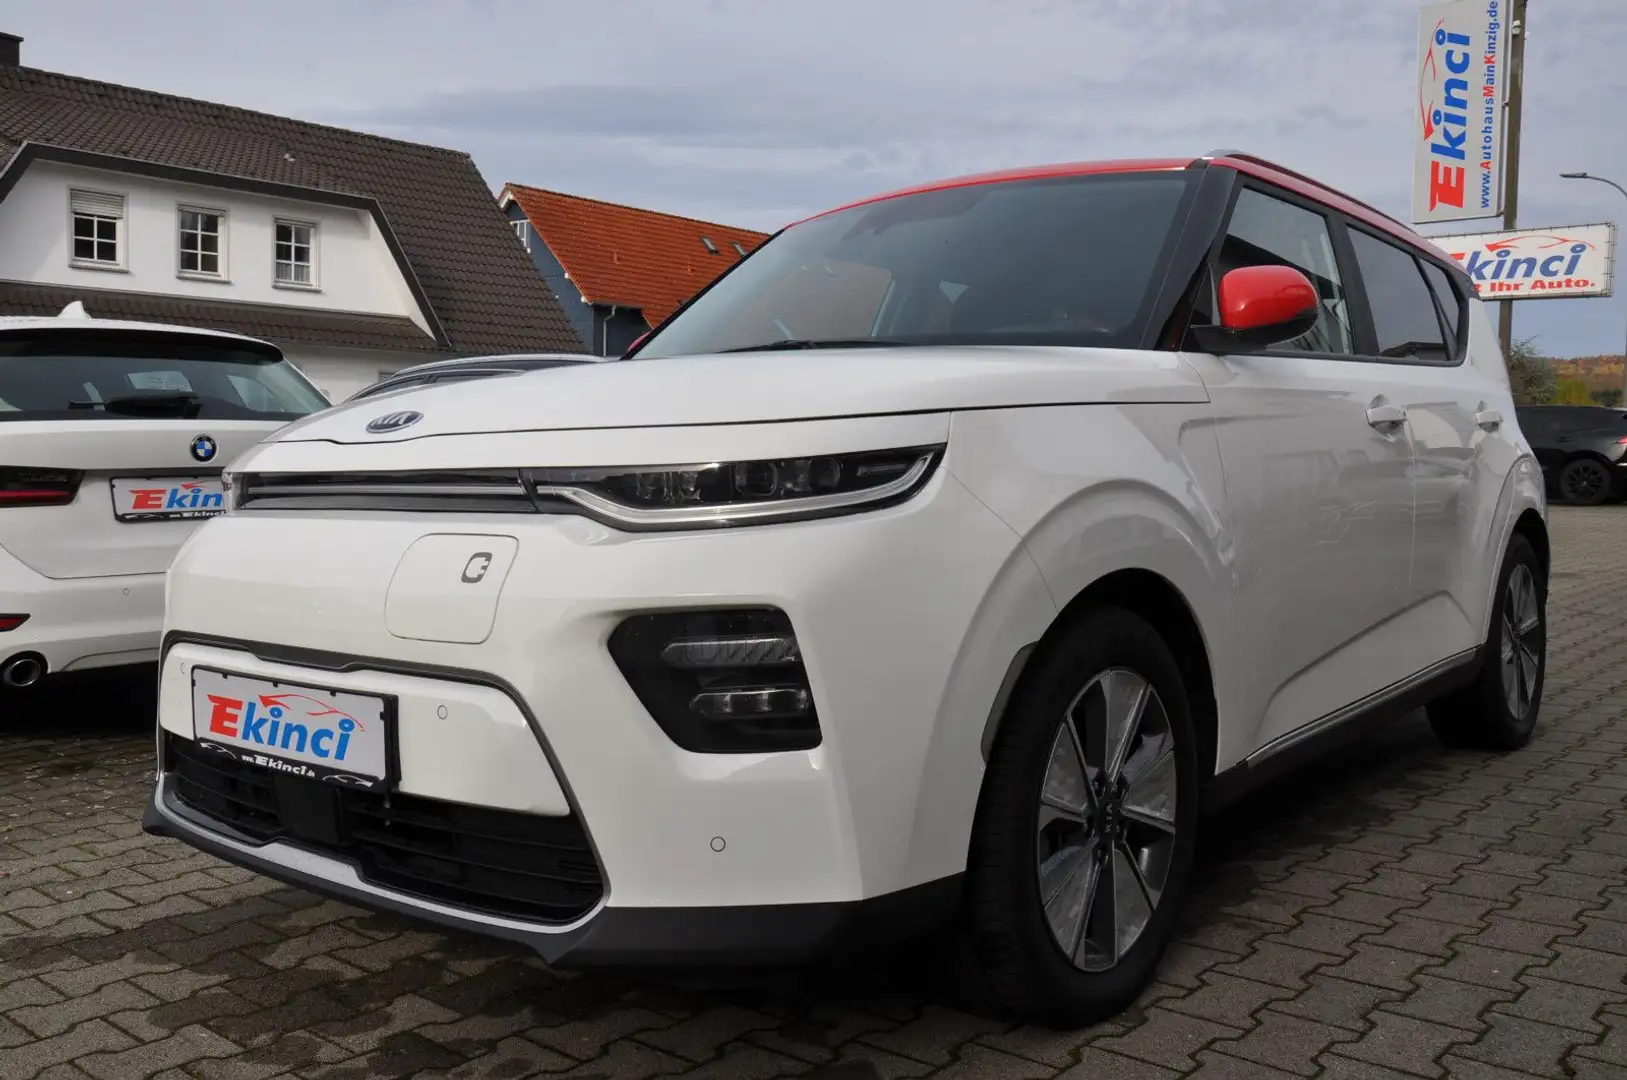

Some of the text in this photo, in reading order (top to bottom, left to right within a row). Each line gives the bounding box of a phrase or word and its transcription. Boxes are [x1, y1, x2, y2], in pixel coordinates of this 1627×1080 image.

[1429, 28, 1471, 213] Ekinci
[1480, 0, 1500, 208] www.AutohausMainKinzig.de
[1490, 282, 1524, 292] Ihr
[1530, 278, 1596, 290] Auto.
[207, 694, 355, 761] Ekinci
